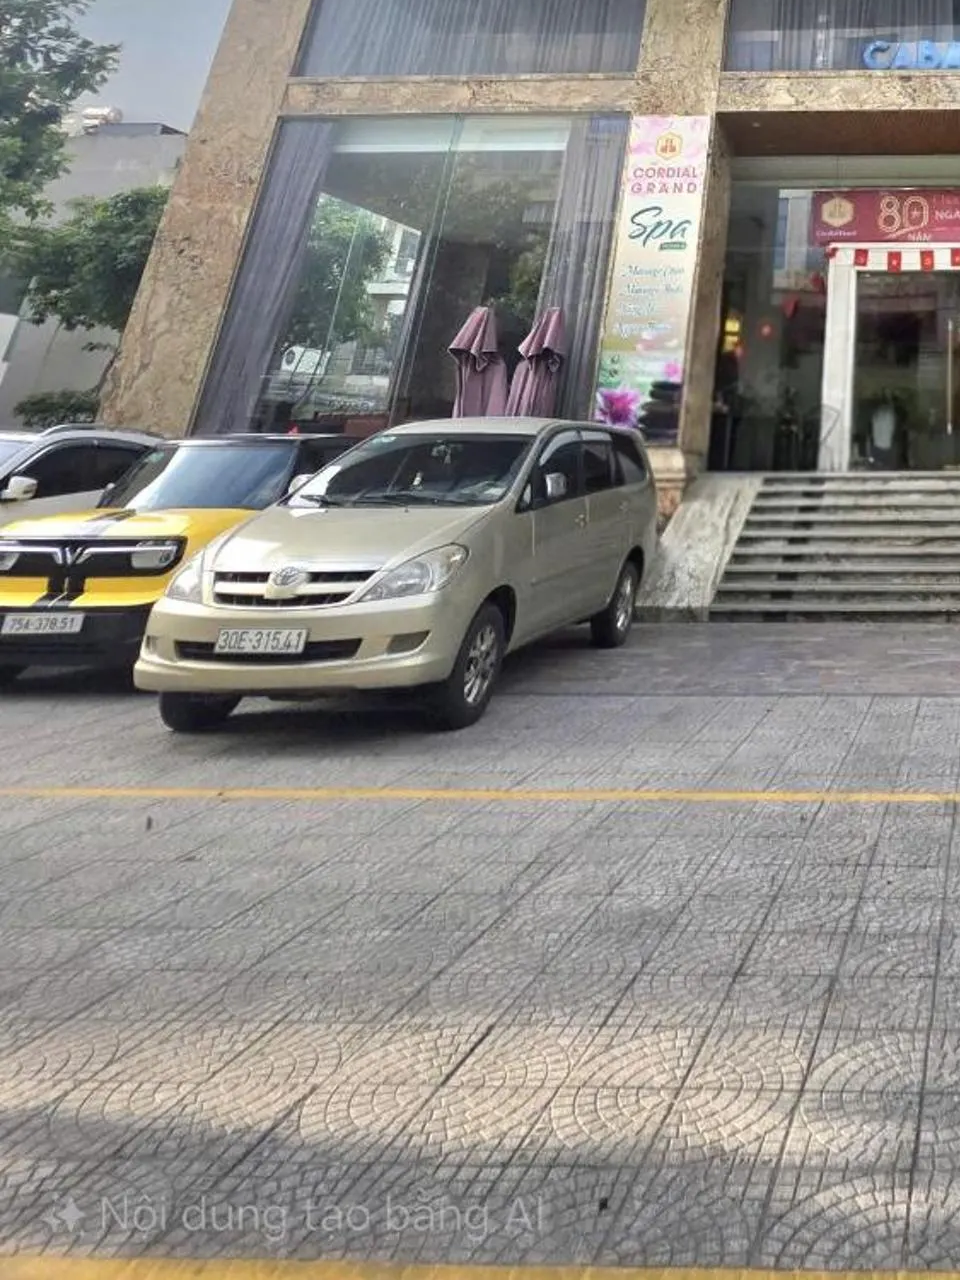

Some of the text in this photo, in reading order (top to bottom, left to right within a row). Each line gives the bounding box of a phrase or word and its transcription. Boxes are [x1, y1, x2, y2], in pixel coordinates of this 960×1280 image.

[633, 166, 698, 179] CORDIAL
[631, 181, 697, 194] GRAND
[628, 205, 692, 248] Spa
[878, 195, 929, 233] 80
